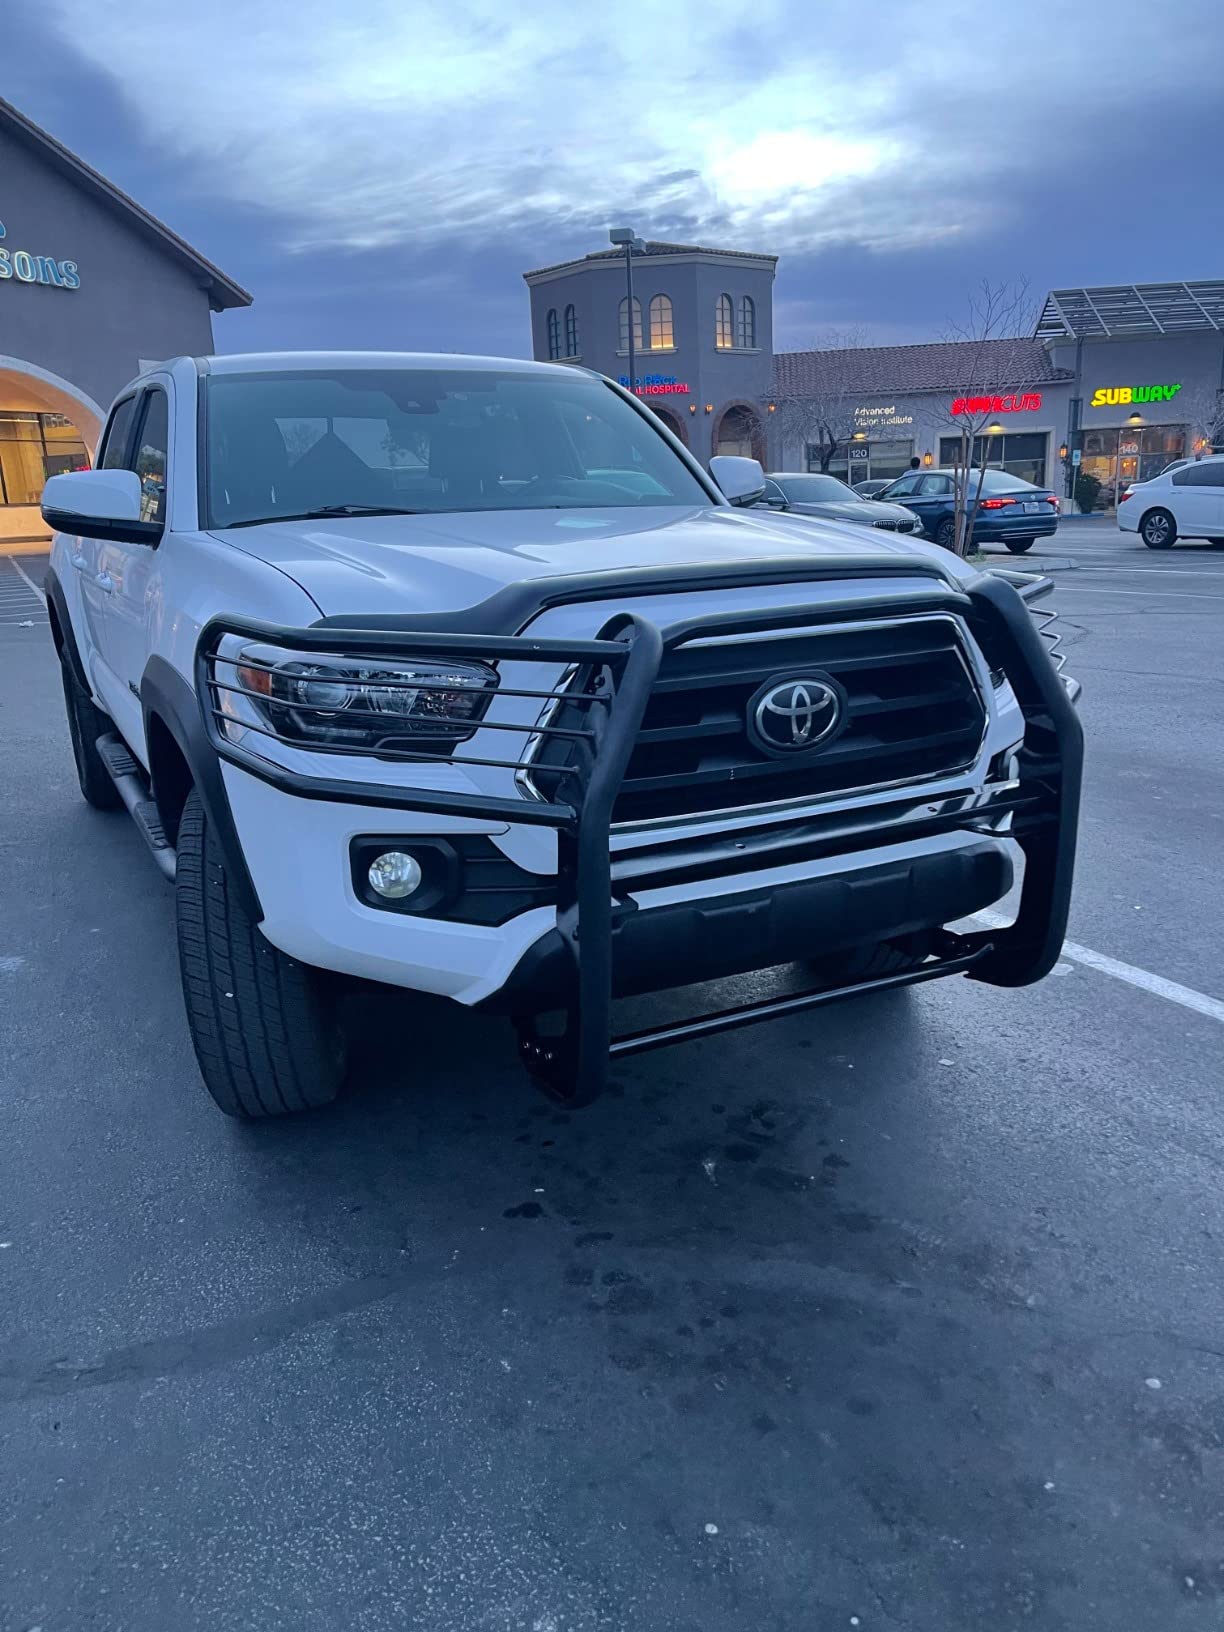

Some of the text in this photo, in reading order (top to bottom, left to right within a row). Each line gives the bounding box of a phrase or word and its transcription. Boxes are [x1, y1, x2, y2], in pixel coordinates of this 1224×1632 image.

[645, 383, 690, 394] HOSPITAL
[1091, 384, 1181, 407] SUBWAY
[854, 406, 896, 416] Advanced
[854, 416, 913, 427] Vision Institute
[851, 449, 867, 458] 120
[1121, 444, 1139, 454] 140
